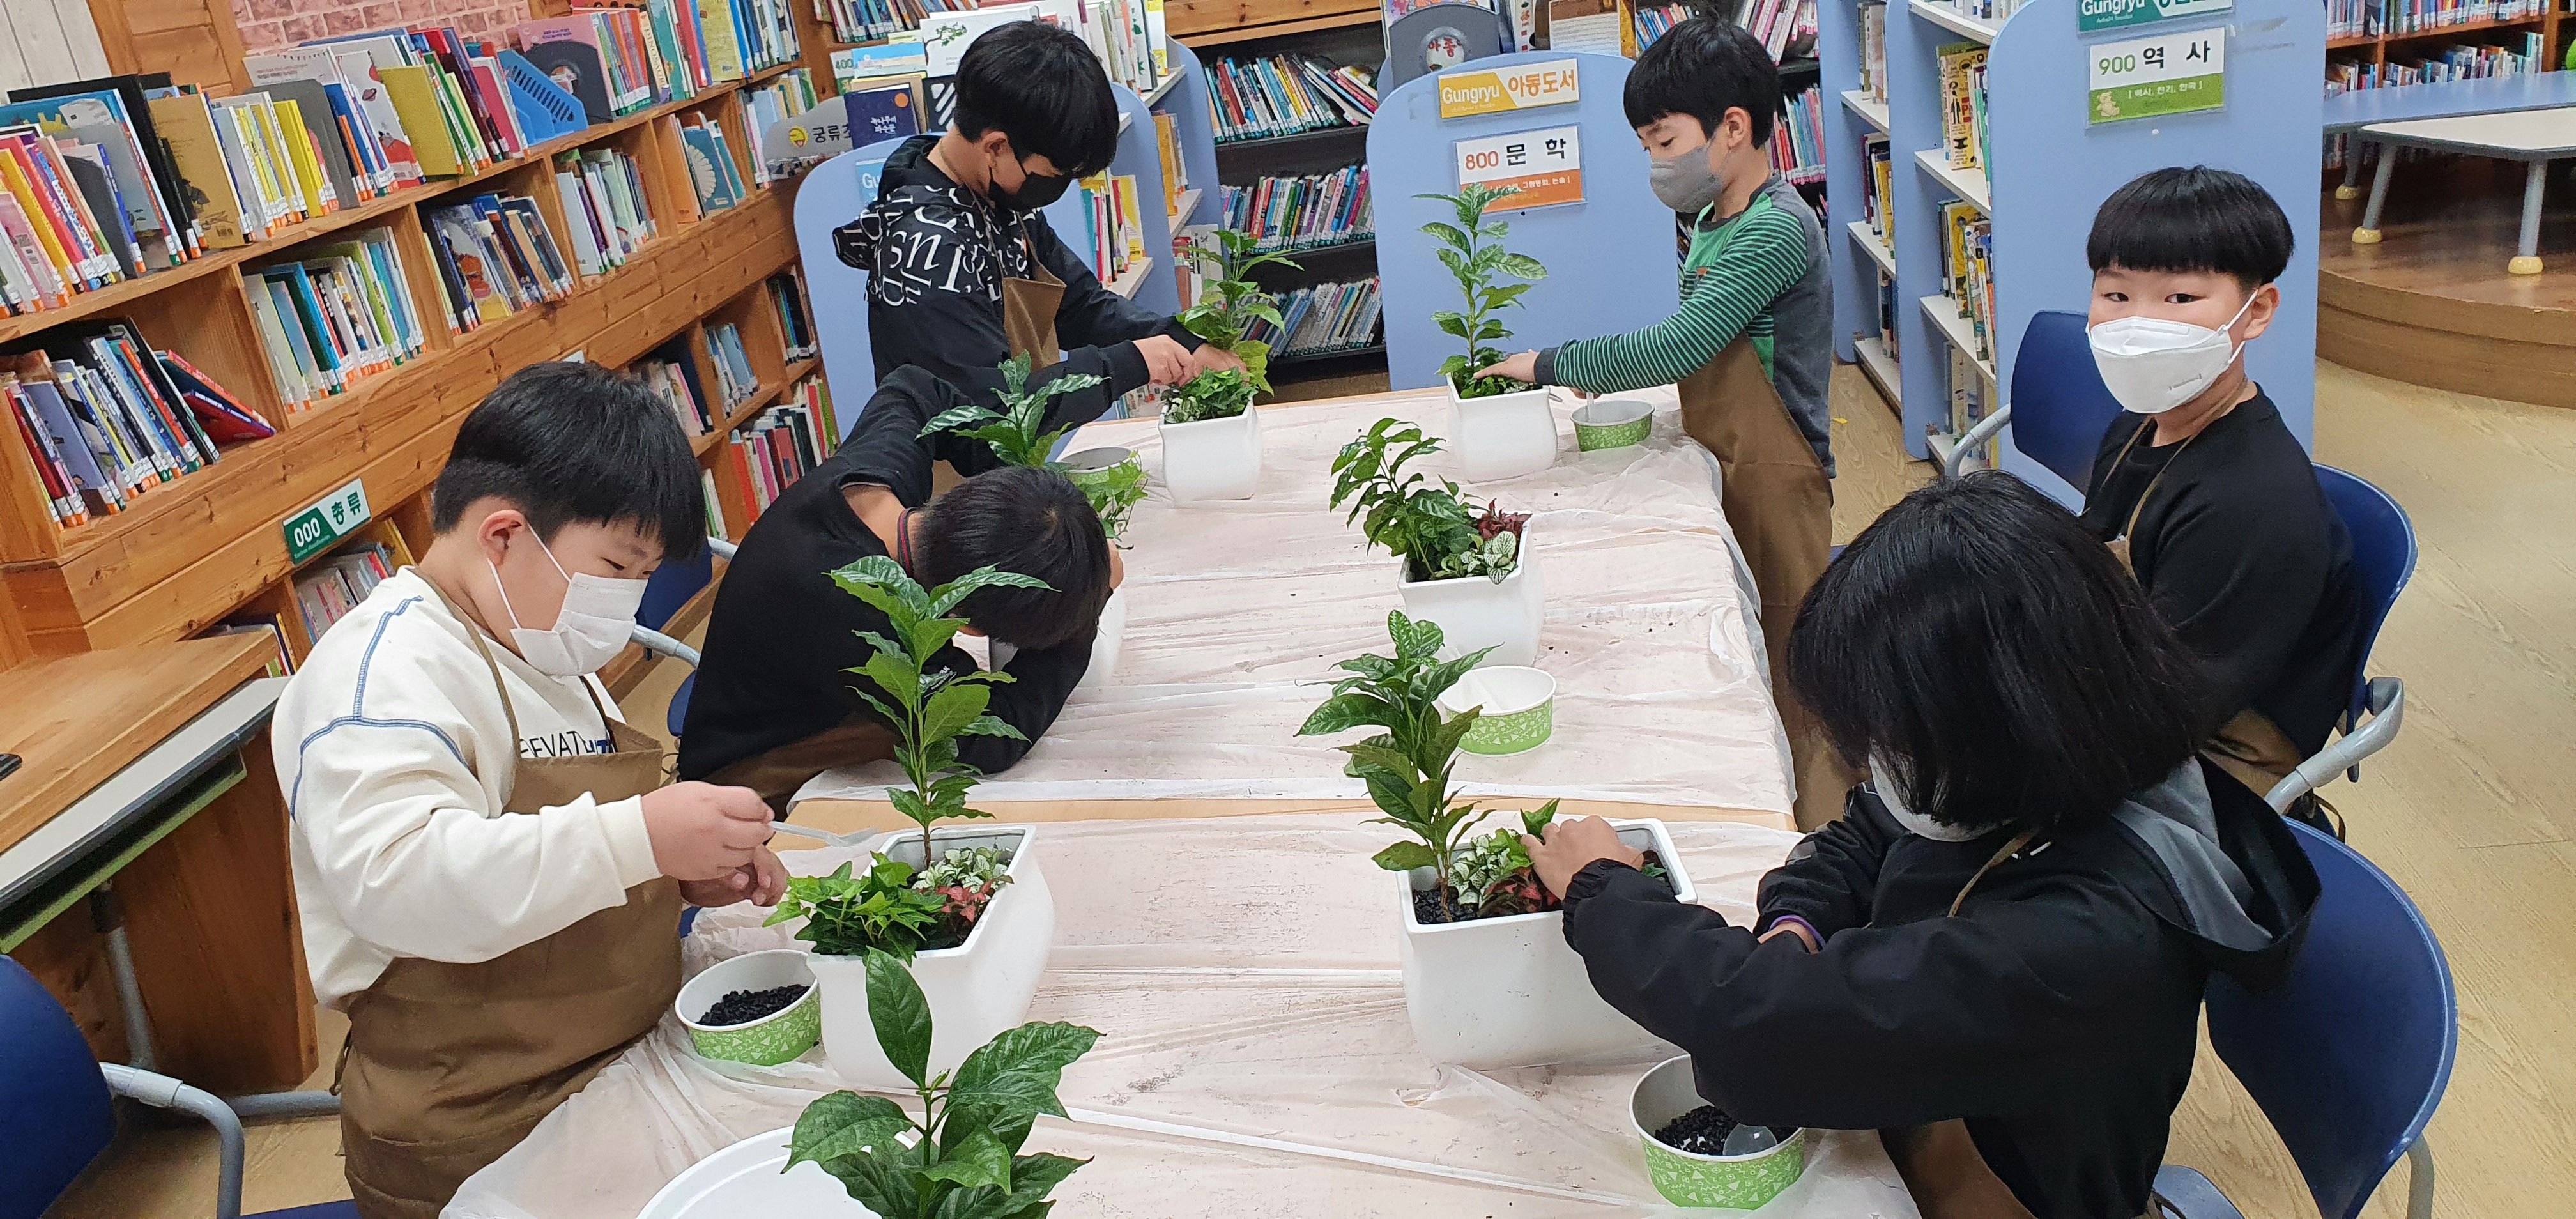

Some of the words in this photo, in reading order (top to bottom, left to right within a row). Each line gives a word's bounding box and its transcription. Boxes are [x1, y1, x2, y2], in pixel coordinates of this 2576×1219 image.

[2099, 55, 2136, 75] 900
[1442, 85, 1500, 104] Gungryu
[1508, 70, 1576, 97] 아동도서
[1466, 151, 1499, 170] 800
[294, 518, 320, 547] 000
